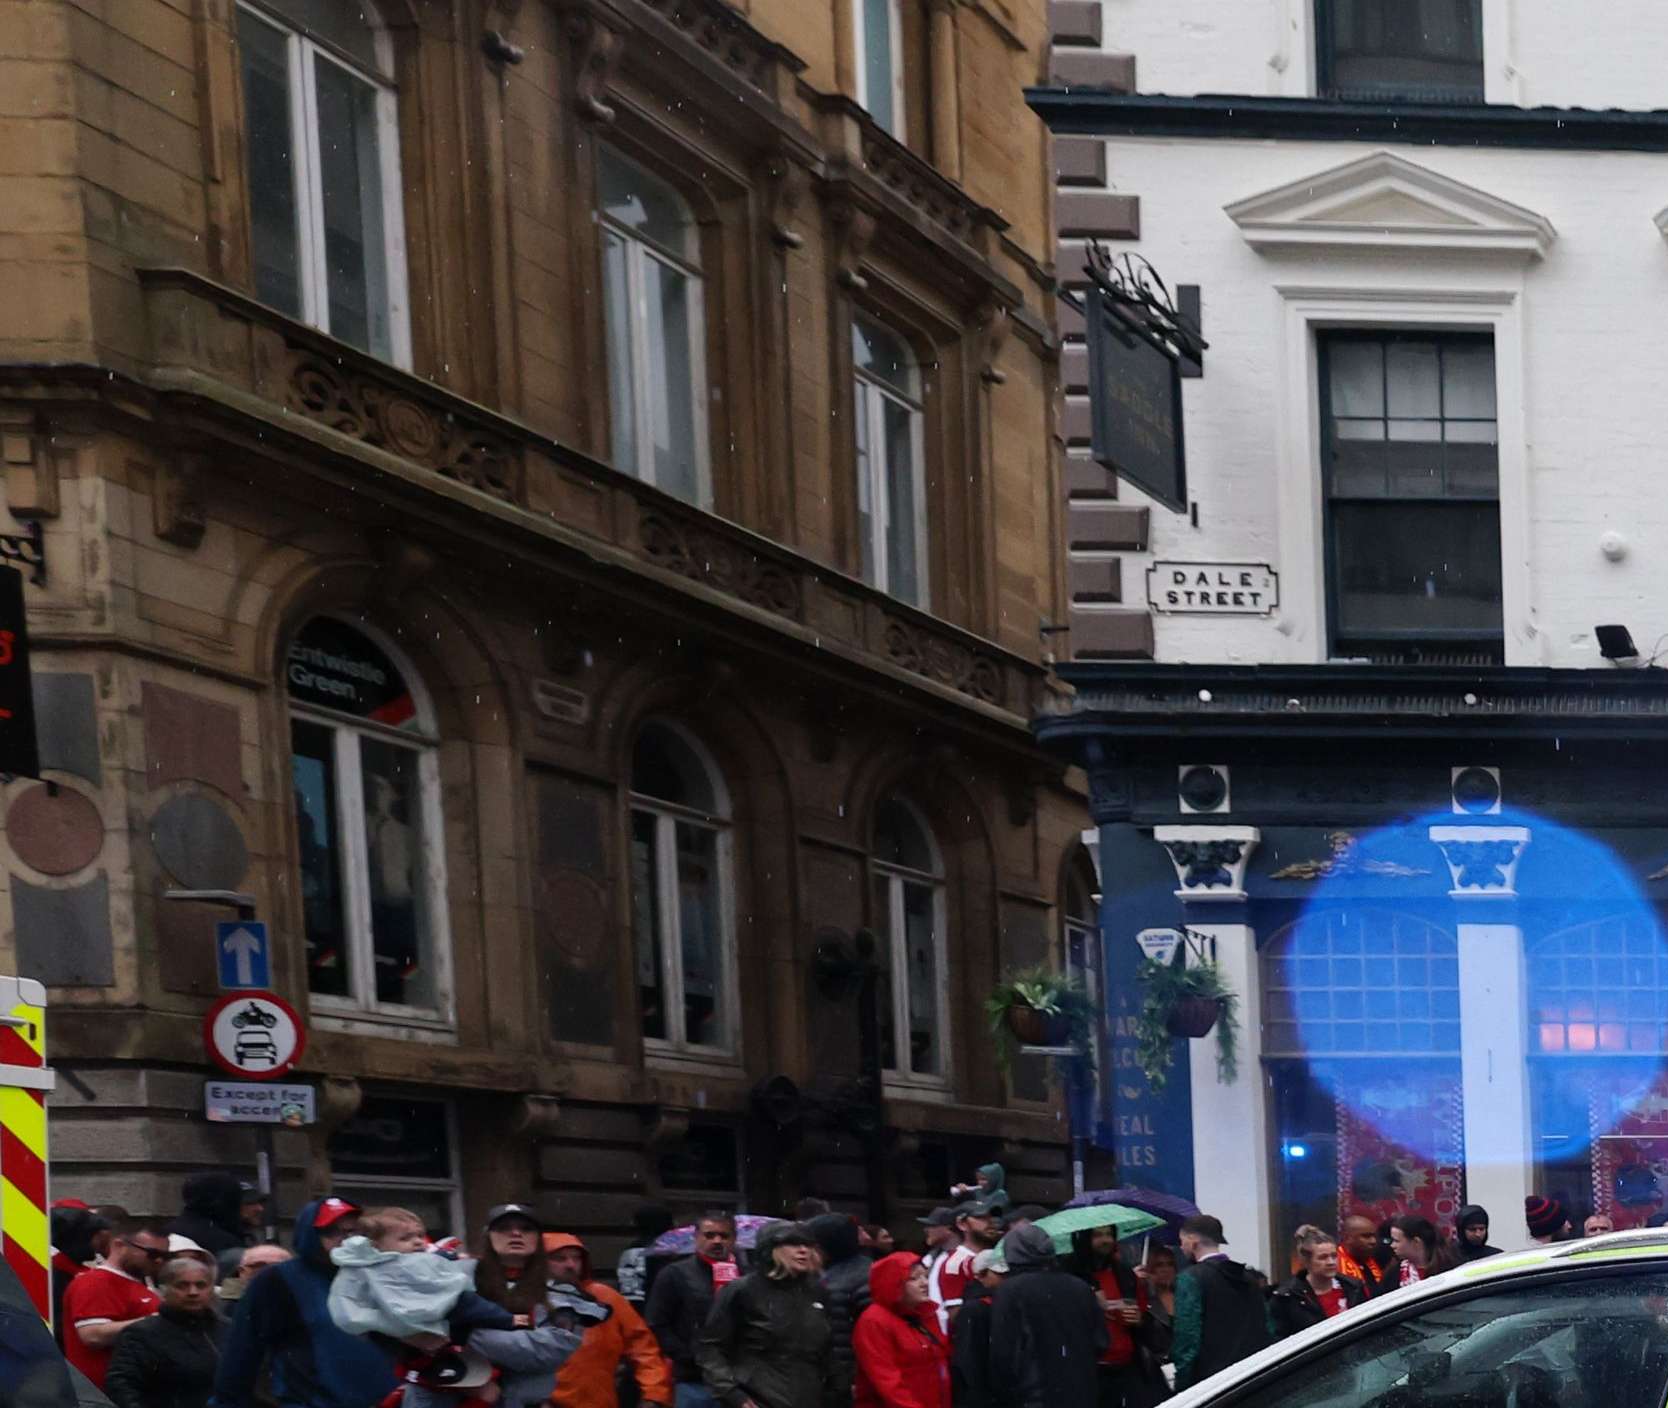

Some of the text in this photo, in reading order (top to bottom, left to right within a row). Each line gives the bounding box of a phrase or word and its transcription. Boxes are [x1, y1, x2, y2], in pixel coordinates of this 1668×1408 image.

[1173, 571, 1252, 586] DALE
[1166, 591, 1262, 605] STREET
[211, 1087, 307, 1101] Except for
[1119, 1115, 1155, 1136] EAL
[1120, 1145, 1156, 1167] LES
